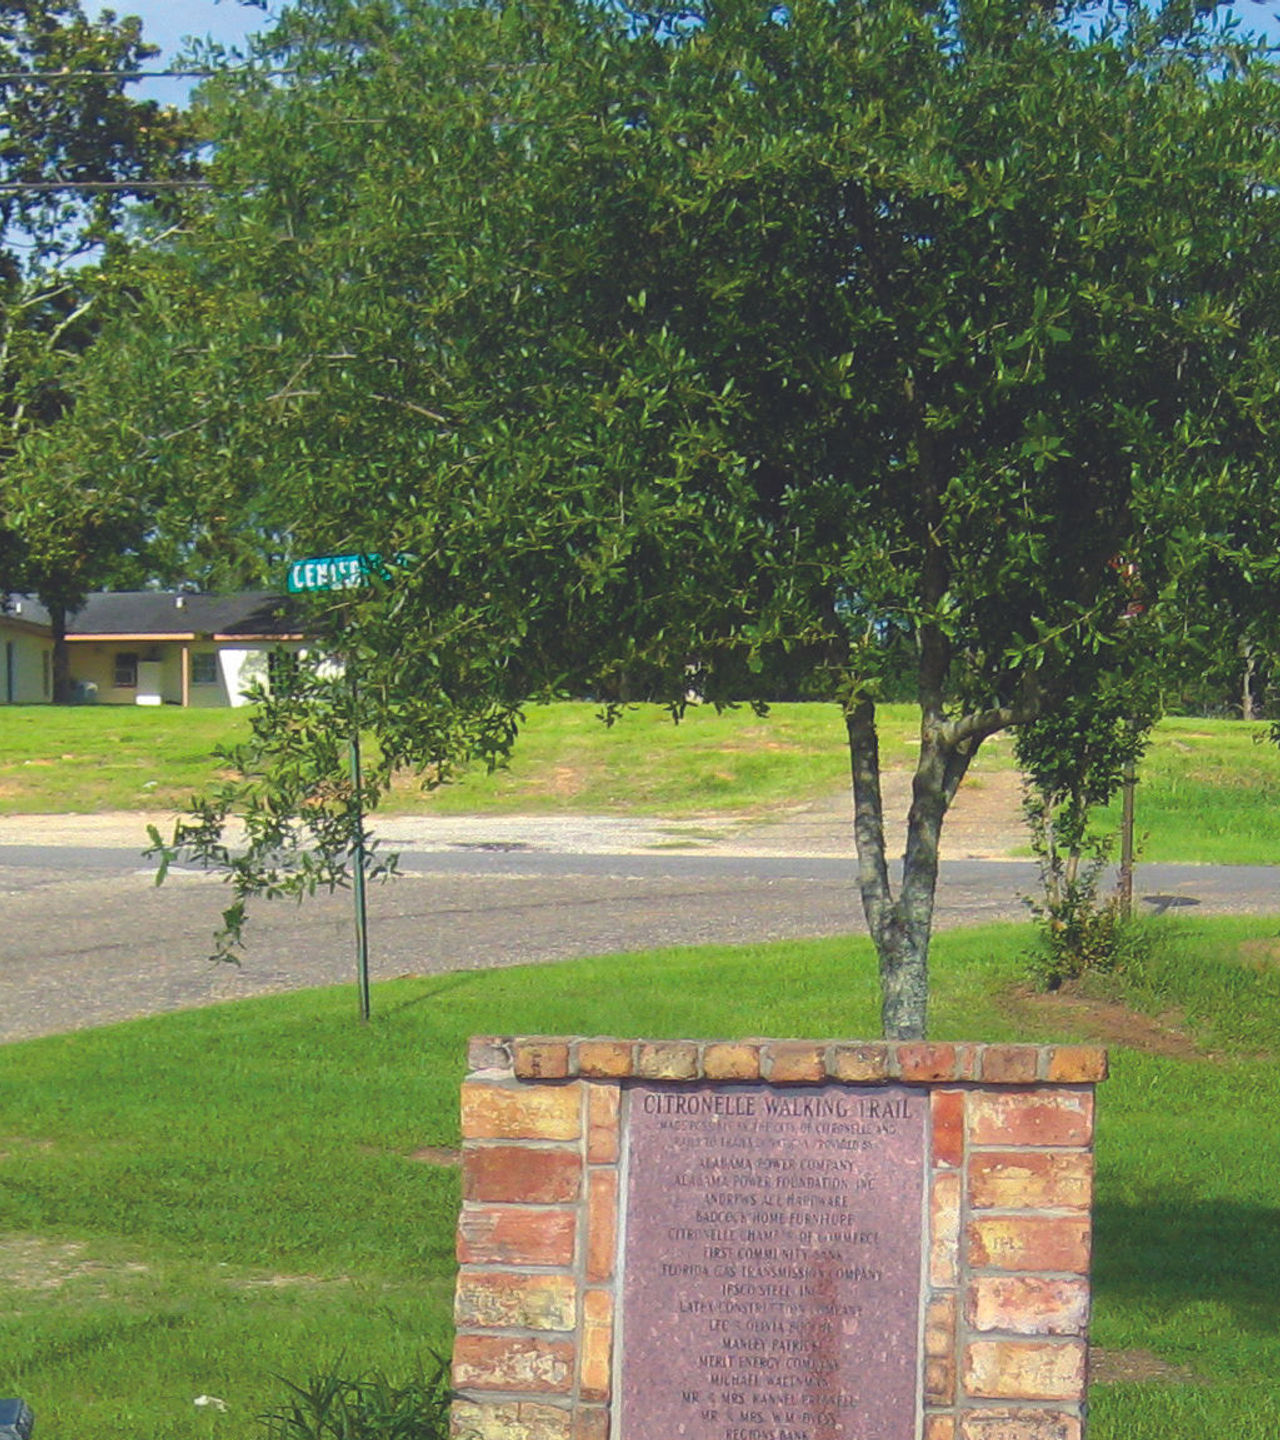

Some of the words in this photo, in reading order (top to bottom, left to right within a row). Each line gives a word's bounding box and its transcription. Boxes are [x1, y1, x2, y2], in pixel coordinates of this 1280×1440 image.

[644, 1094, 755, 1116] CITRONELLE
[764, 1096, 847, 1118] WALKING
[859, 1098, 912, 1119] TRAIL
[700, 1156, 753, 1170] ALABAMA
[757, 1158, 795, 1171] POWER
[799, 1158, 853, 1173] COMPANY
[676, 1174, 729, 1187] ALABAMA
[733, 1175, 771, 1188] POWER
[752, 1212, 785, 1225] HOME
[739, 1229, 794, 1242] CHAM
[800, 1231, 812, 1244] OF
[704, 1247, 732, 1259] FIRST
[737, 1248, 807, 1261] COMMUNITY
[662, 1263, 709, 1276] FLORIDA
[714, 1265, 736, 1278] GAS
[699, 1355, 733, 1368] MERIT
[738, 1356, 779, 1369] ENERGY
[710, 1374, 758, 1387] MICHAEL
[726, 1428, 775, 1440] REGIONS
